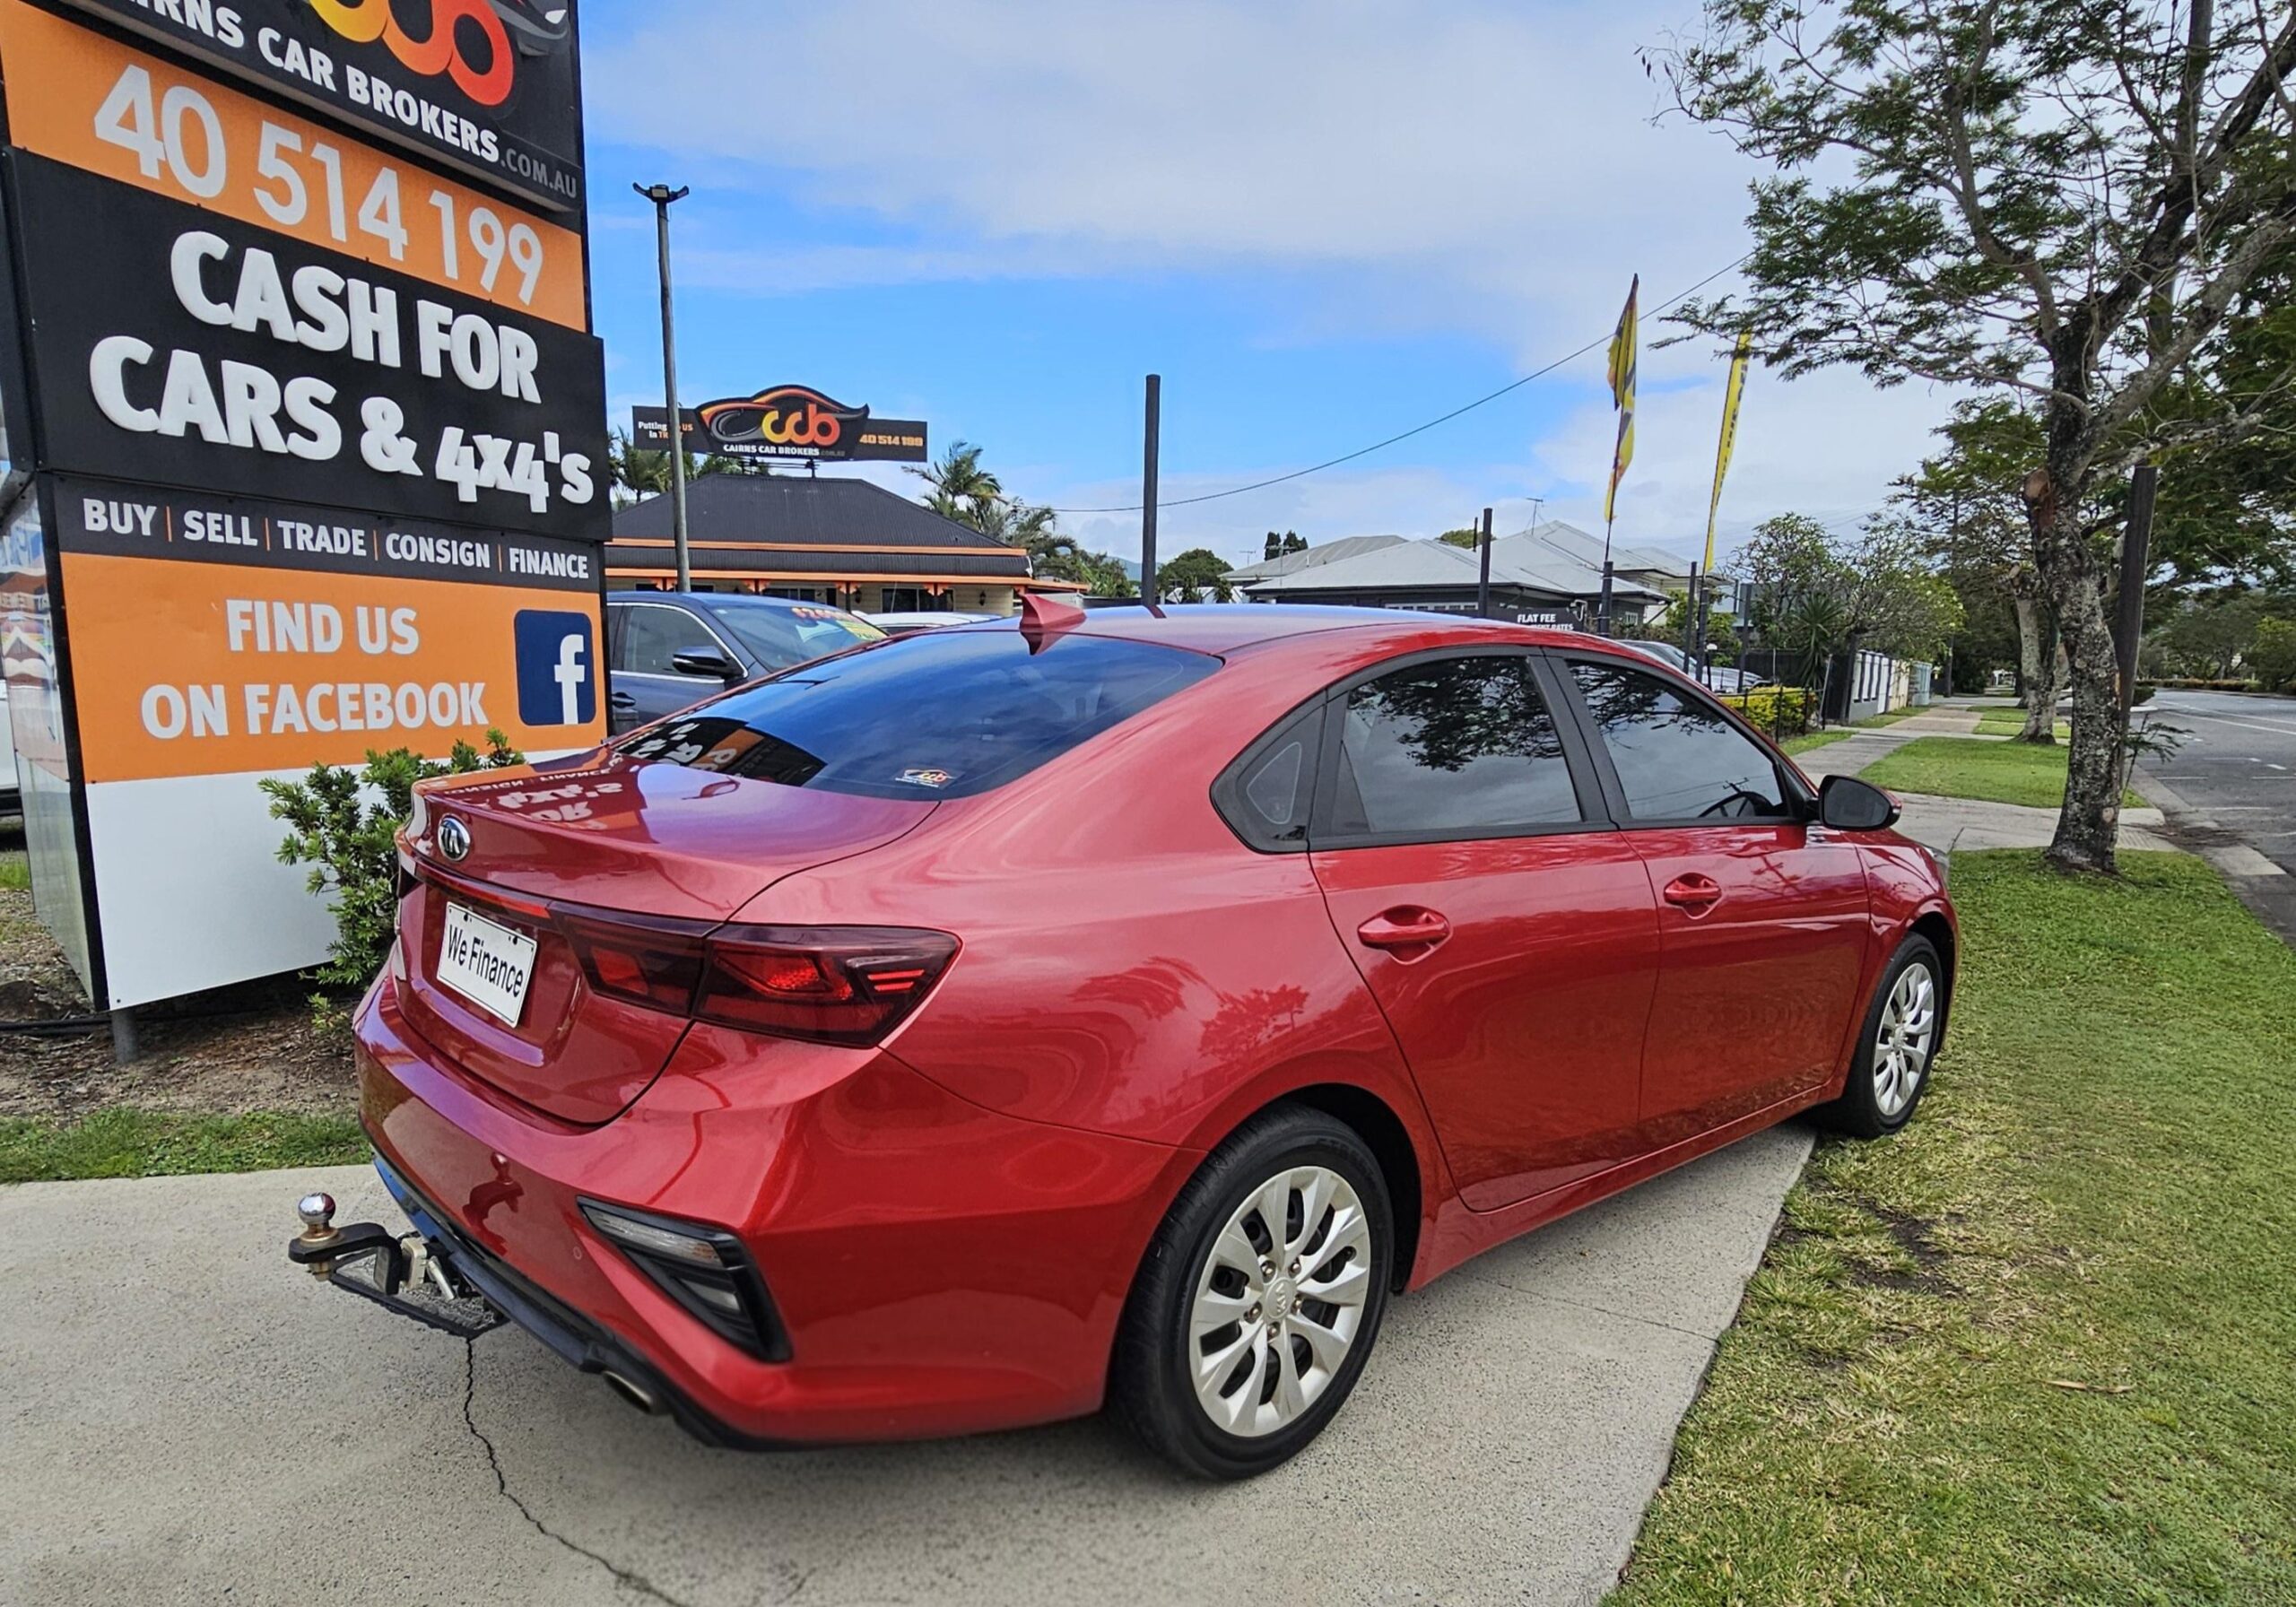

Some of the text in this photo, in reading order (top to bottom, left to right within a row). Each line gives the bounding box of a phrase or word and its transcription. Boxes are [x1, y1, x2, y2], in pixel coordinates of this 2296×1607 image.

[257, 27, 337, 91] CAR
[94, 64, 544, 306] 40 514 199
[170, 230, 542, 404] CASH FOR
[90, 335, 343, 461] CARS
[361, 396, 423, 476] &
[638, 421, 668, 431] Putting
[723, 444, 757, 454] CAIRNS
[758, 445, 777, 455] CAR
[859, 434, 874, 444] 40
[878, 435, 900, 445] 514
[83, 498, 589, 580] BUY SELL TRADE CONSIGN FINANCE
[225, 598, 420, 656] FIND US
[1517, 613, 1557, 623] FLAT FEE
[141, 682, 490, 740] ON FACEBOOK
[448, 923, 524, 999] We Finance
